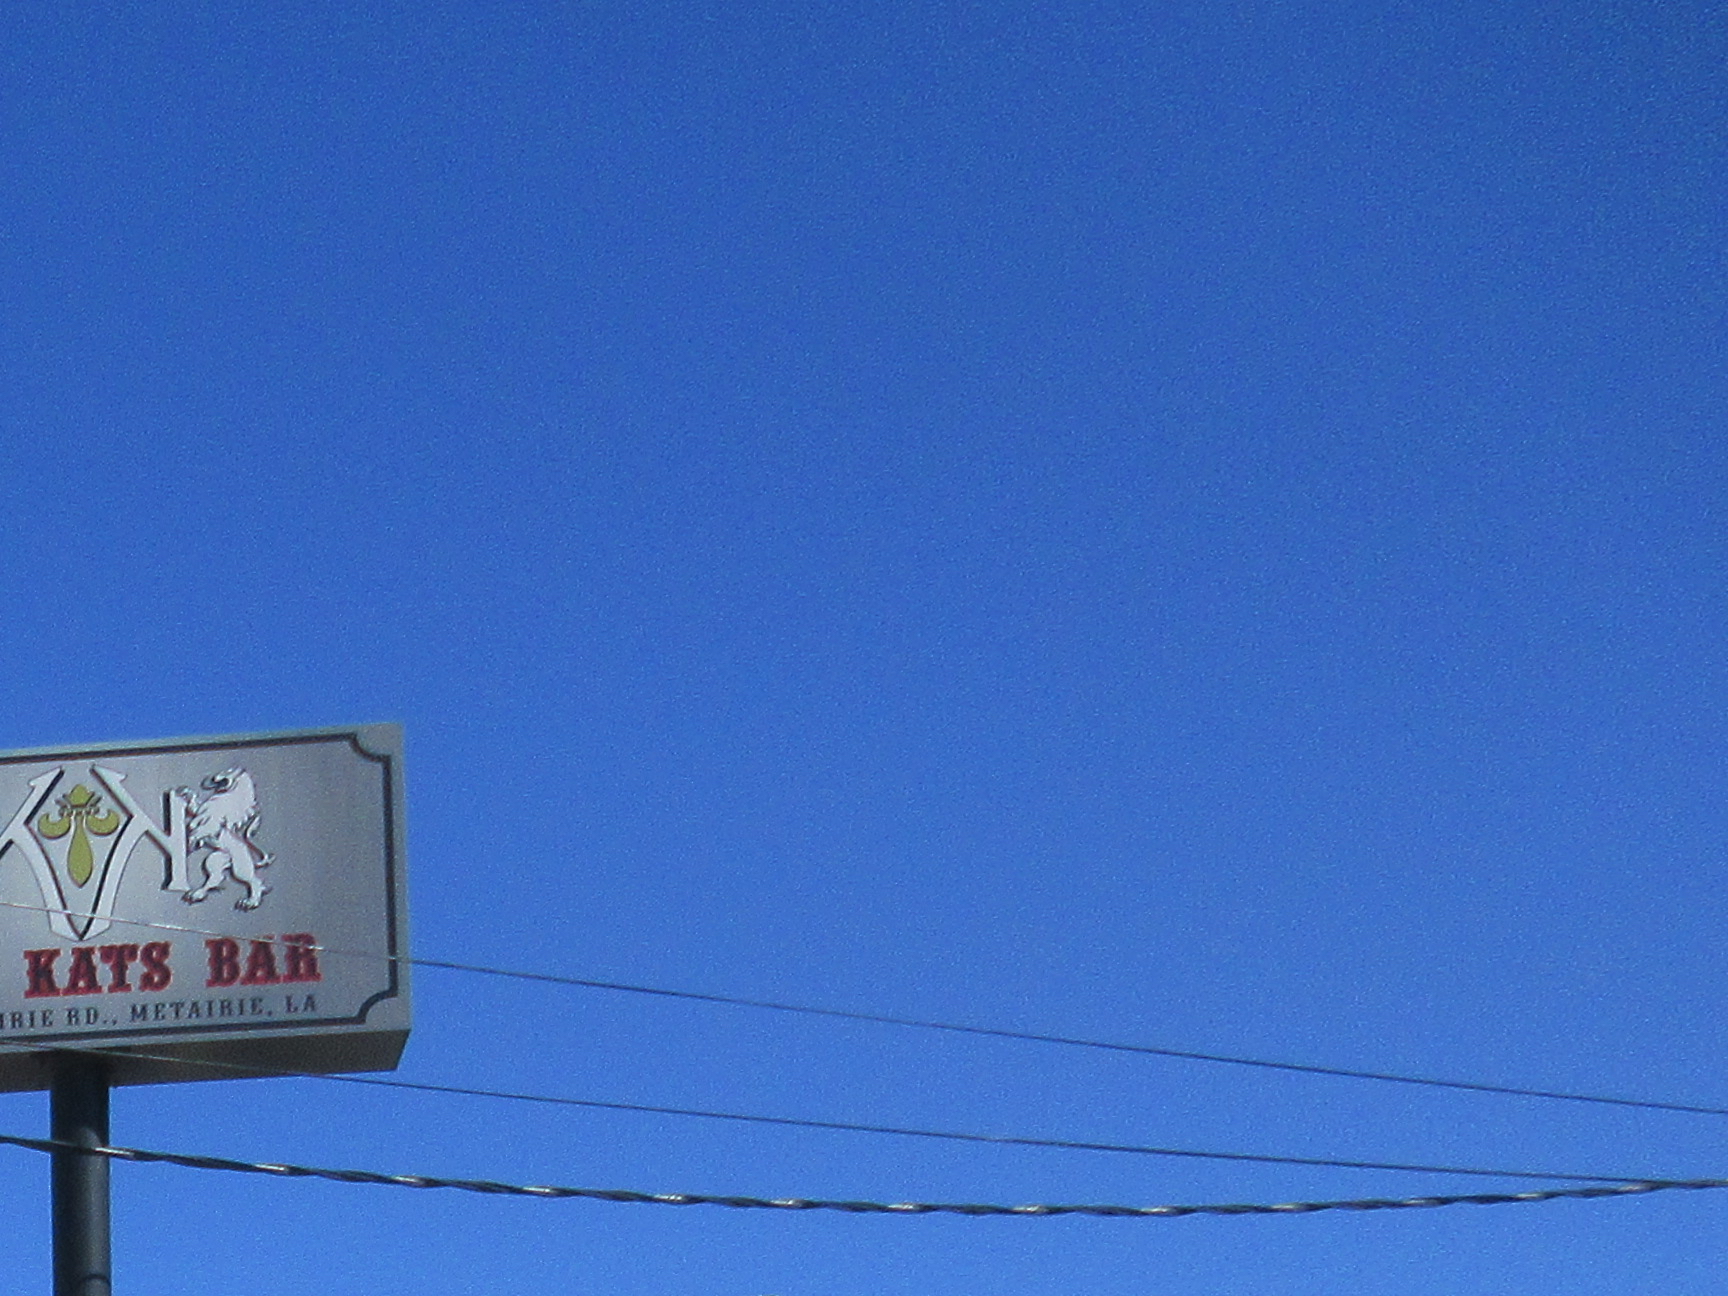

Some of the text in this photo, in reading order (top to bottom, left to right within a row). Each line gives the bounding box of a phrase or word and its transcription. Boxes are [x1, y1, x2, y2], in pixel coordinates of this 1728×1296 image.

[23, 941, 172, 998] KATS
[205, 933, 323, 988] BAR
[286, 994, 317, 1013] LA
